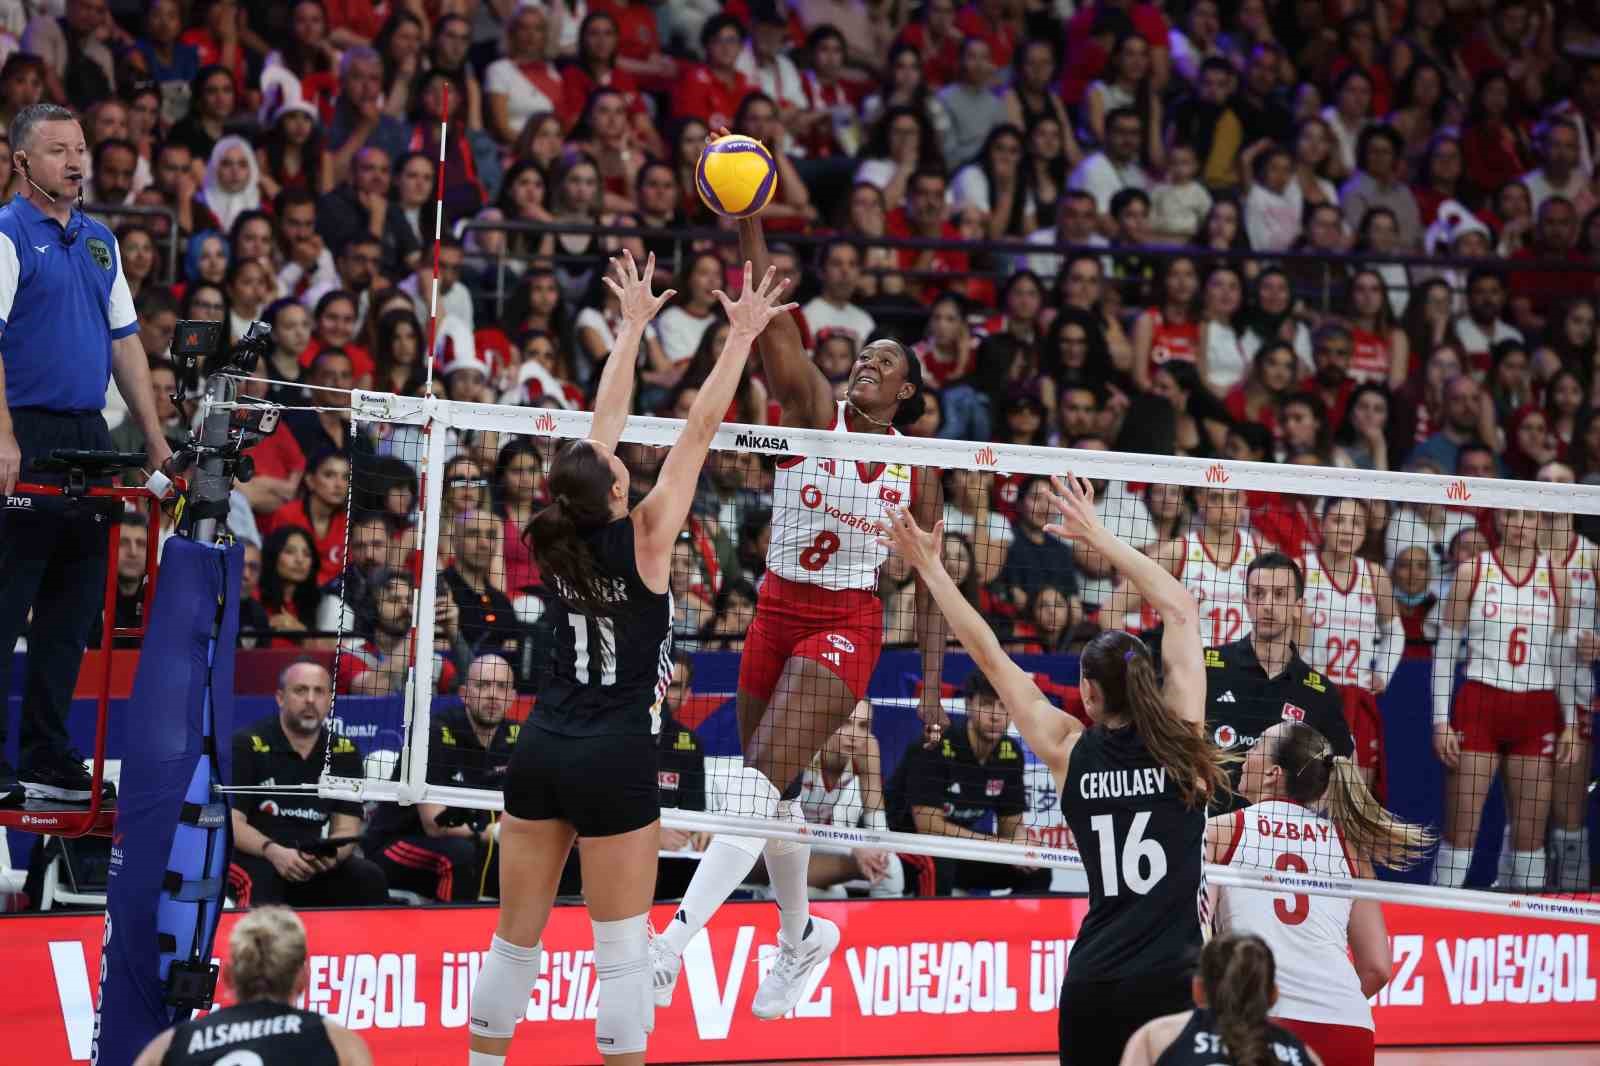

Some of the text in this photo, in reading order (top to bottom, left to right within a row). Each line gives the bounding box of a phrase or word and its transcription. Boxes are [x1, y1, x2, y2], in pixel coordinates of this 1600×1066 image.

[799, 531, 840, 571] 8
[567, 612, 617, 686] 11
[1208, 607, 1241, 648] 12
[1507, 626, 1528, 666] 6
[1325, 635, 1361, 680] 22
[1079, 766, 1167, 800] CEKULAEV
[1257, 814, 1330, 842] ÖZBAY
[1090, 810, 1168, 897] 16
[1273, 853, 1310, 926] 3
[845, 939, 1018, 1017] VOLEYBOL
[1435, 933, 1598, 1006] VOLEYBOL
[294, 952, 426, 1031] EYBOL
[187, 1013, 302, 1055] ALSMEIER
[1193, 1031, 1303, 1066] STBE
